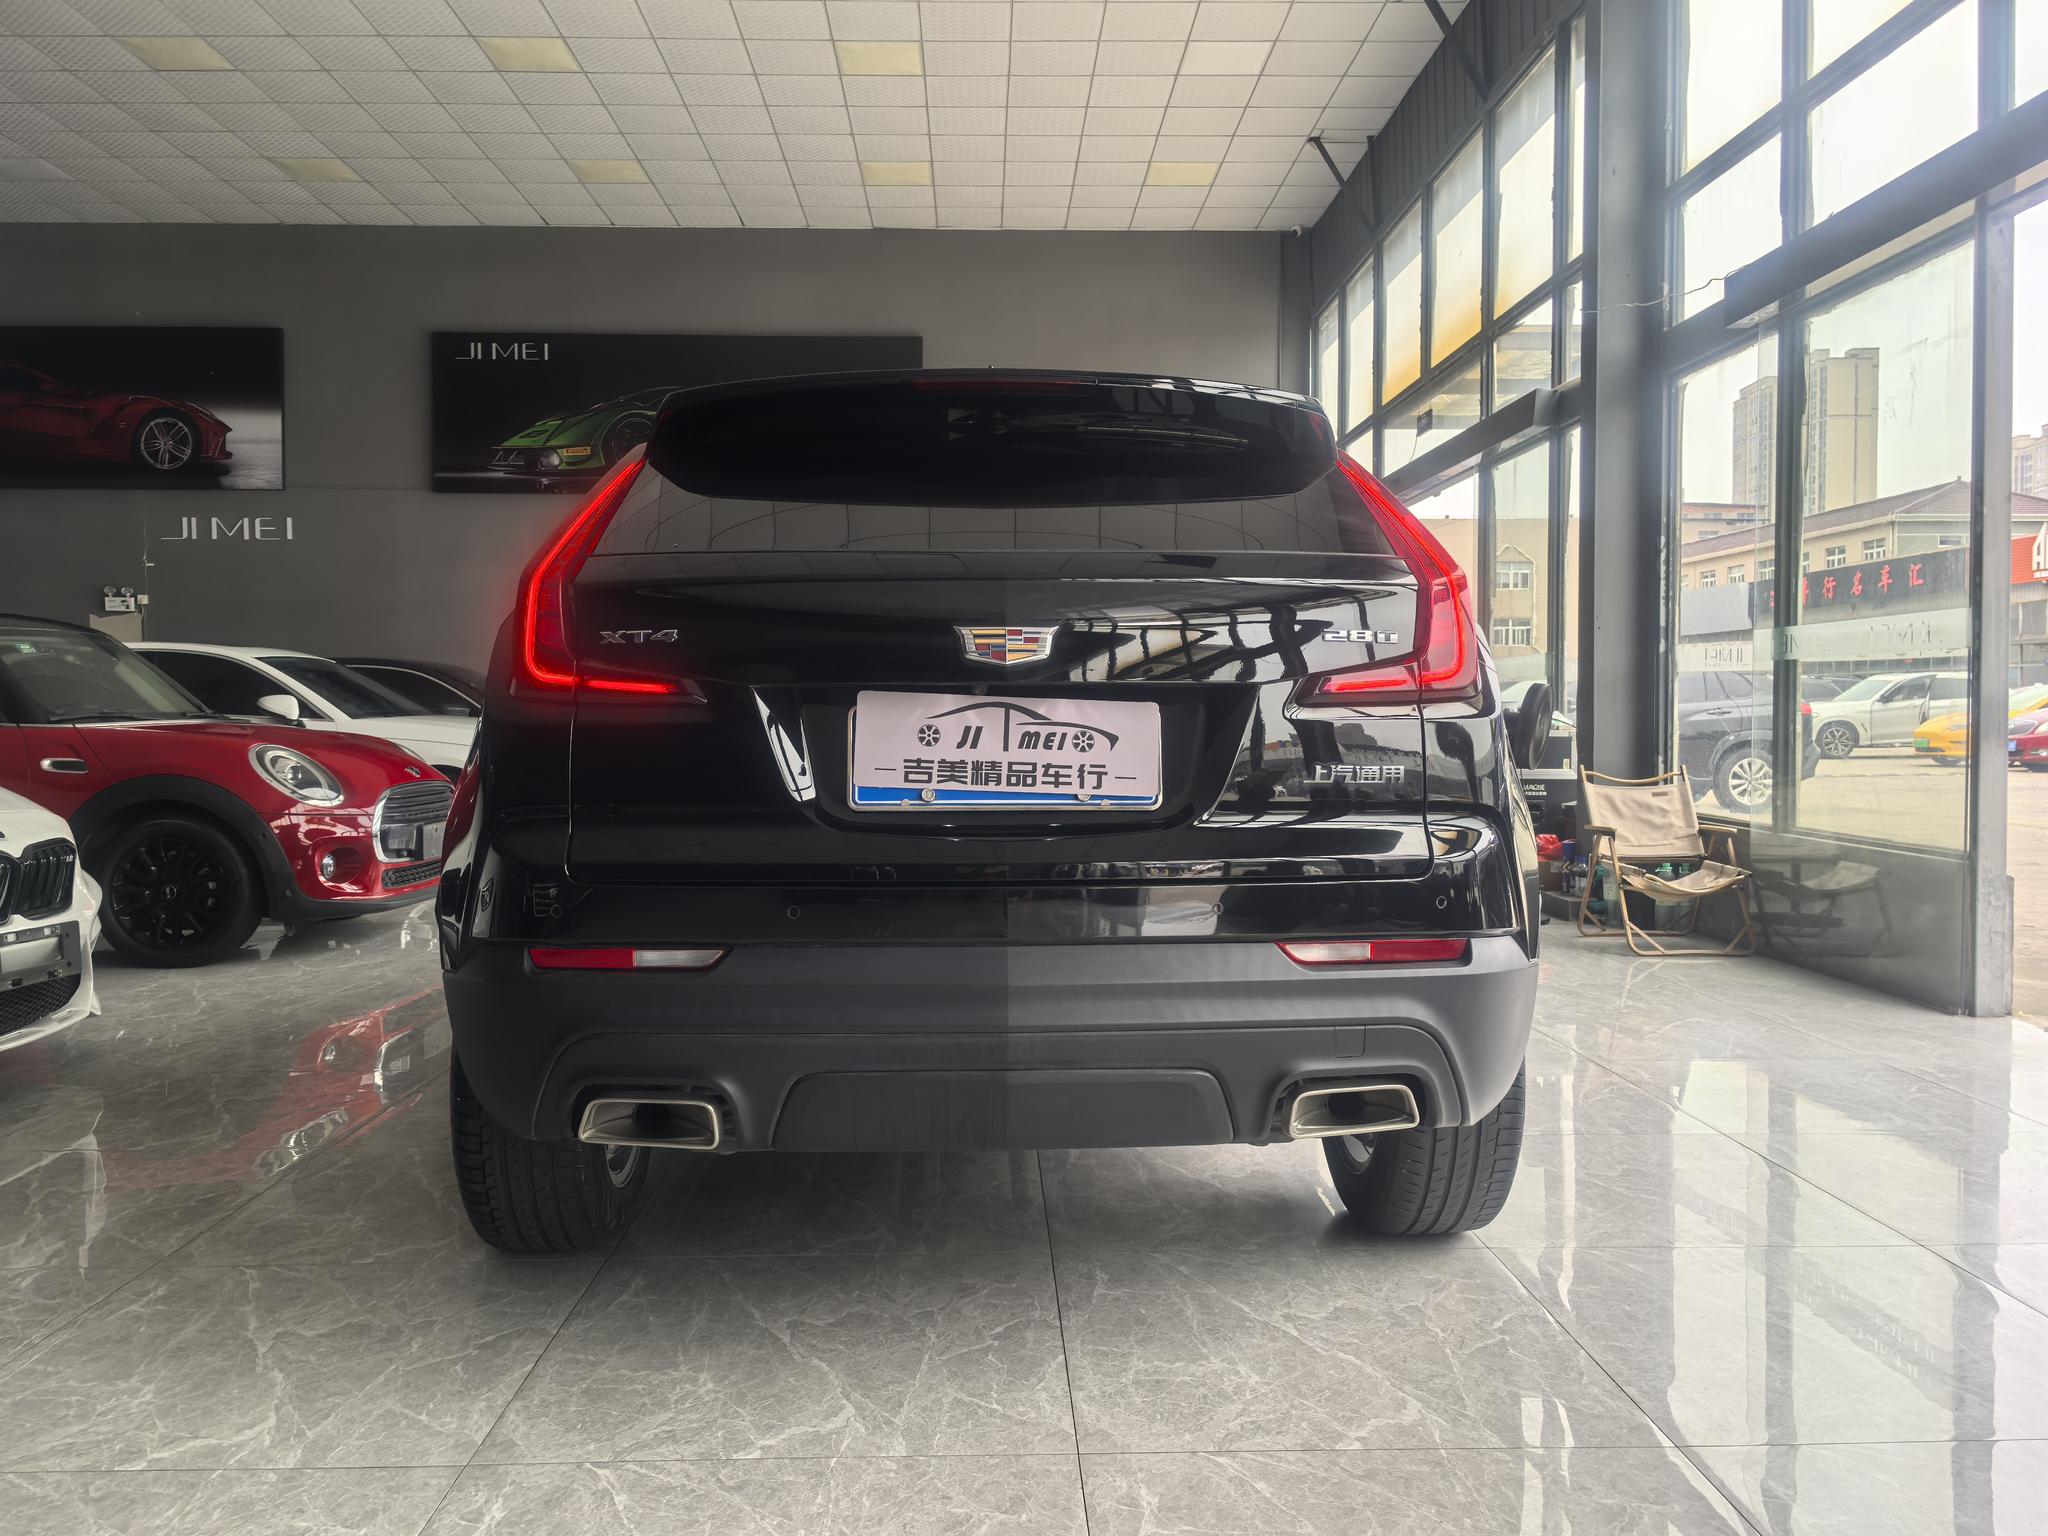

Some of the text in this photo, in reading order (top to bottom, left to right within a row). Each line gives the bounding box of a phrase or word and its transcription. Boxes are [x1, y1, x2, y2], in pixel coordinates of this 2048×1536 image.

[454, 342, 549, 361] JI MEI
[160, 516, 294, 541] JI MEI
[599, 629, 679, 645] XT4
[1322, 629, 1399, 644] 28T
[955, 725, 1068, 751] JI MEI
[902, 757, 1109, 789] 吉美精品车行
[1302, 764, 1405, 784] 上汽通用
